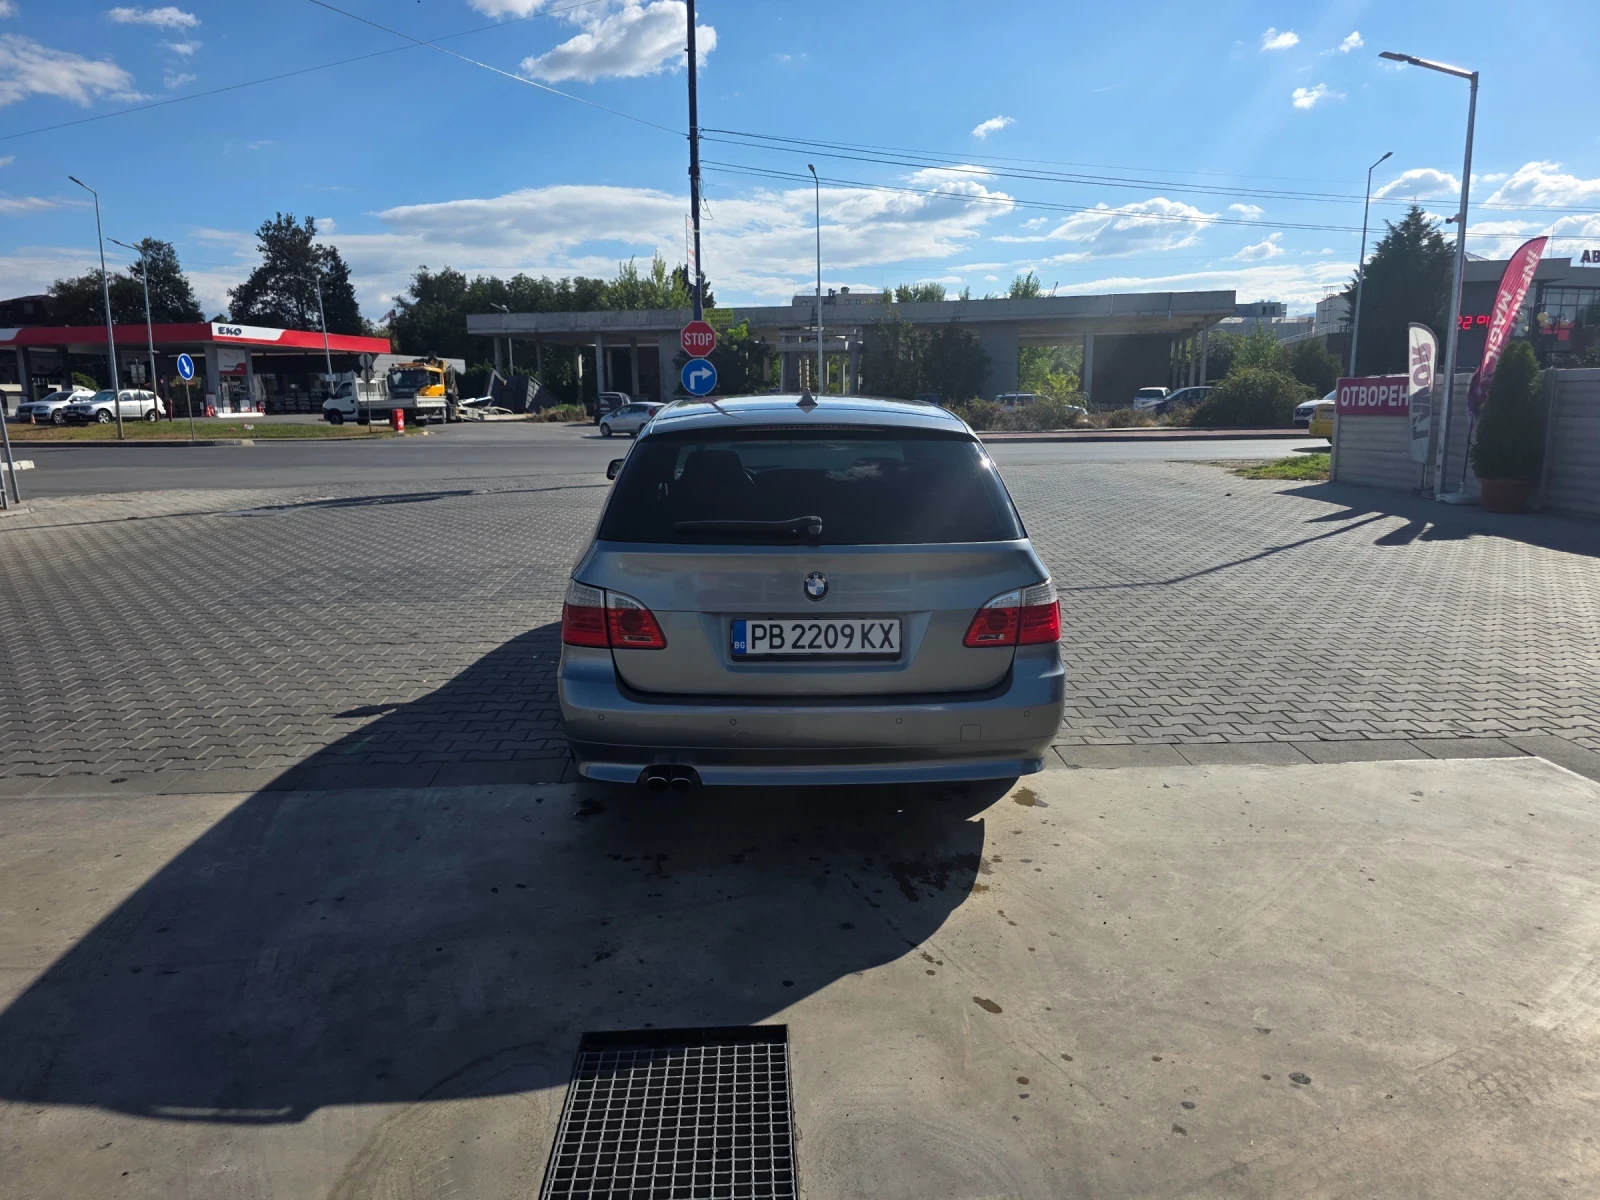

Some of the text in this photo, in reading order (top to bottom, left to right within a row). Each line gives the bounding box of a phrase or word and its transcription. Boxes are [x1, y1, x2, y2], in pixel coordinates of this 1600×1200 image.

[218, 326, 242, 336] EKO
[684, 332, 713, 346] STOP
[751, 623, 895, 649] PB 2209 KX
[734, 641, 745, 649] BG
